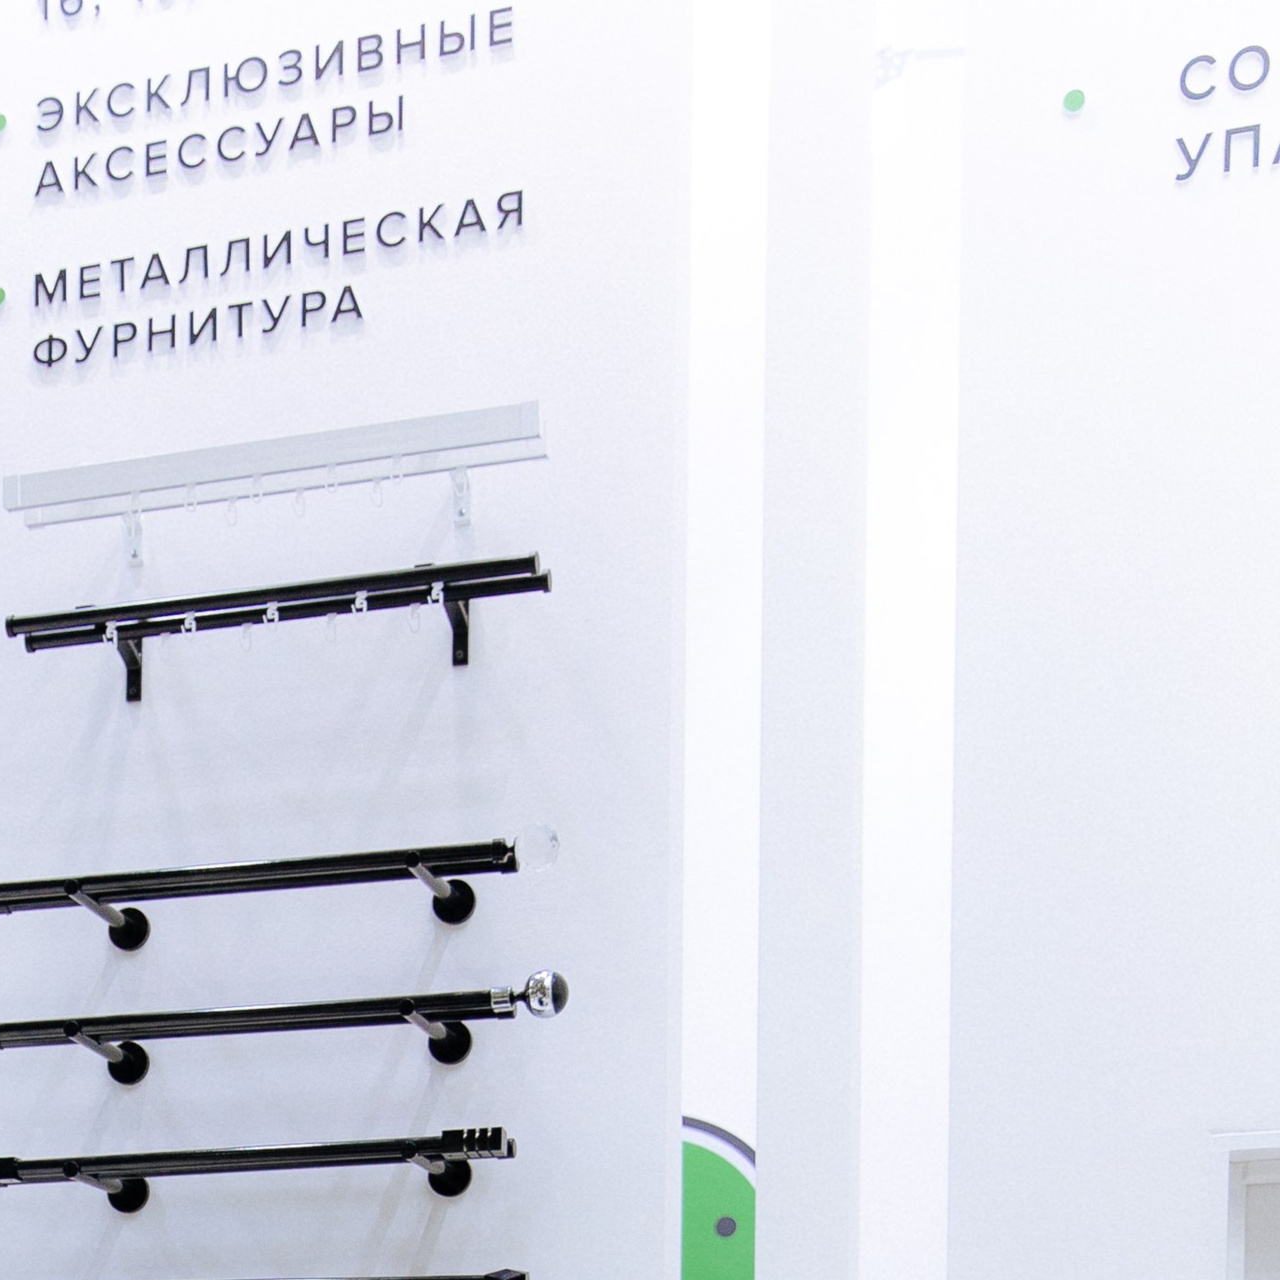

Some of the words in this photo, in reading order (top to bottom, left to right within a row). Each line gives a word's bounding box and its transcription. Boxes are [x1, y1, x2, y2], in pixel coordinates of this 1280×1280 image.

[36, 6, 514, 132] ЭКСКЛЮЗИВНЫЕ
[33, 95, 406, 198] АКСЕССУАРЫ
[33, 189, 524, 307] МЕТАЛЛИЧЕСКАЯ
[33, 285, 364, 367] ФУРНИТУРА
